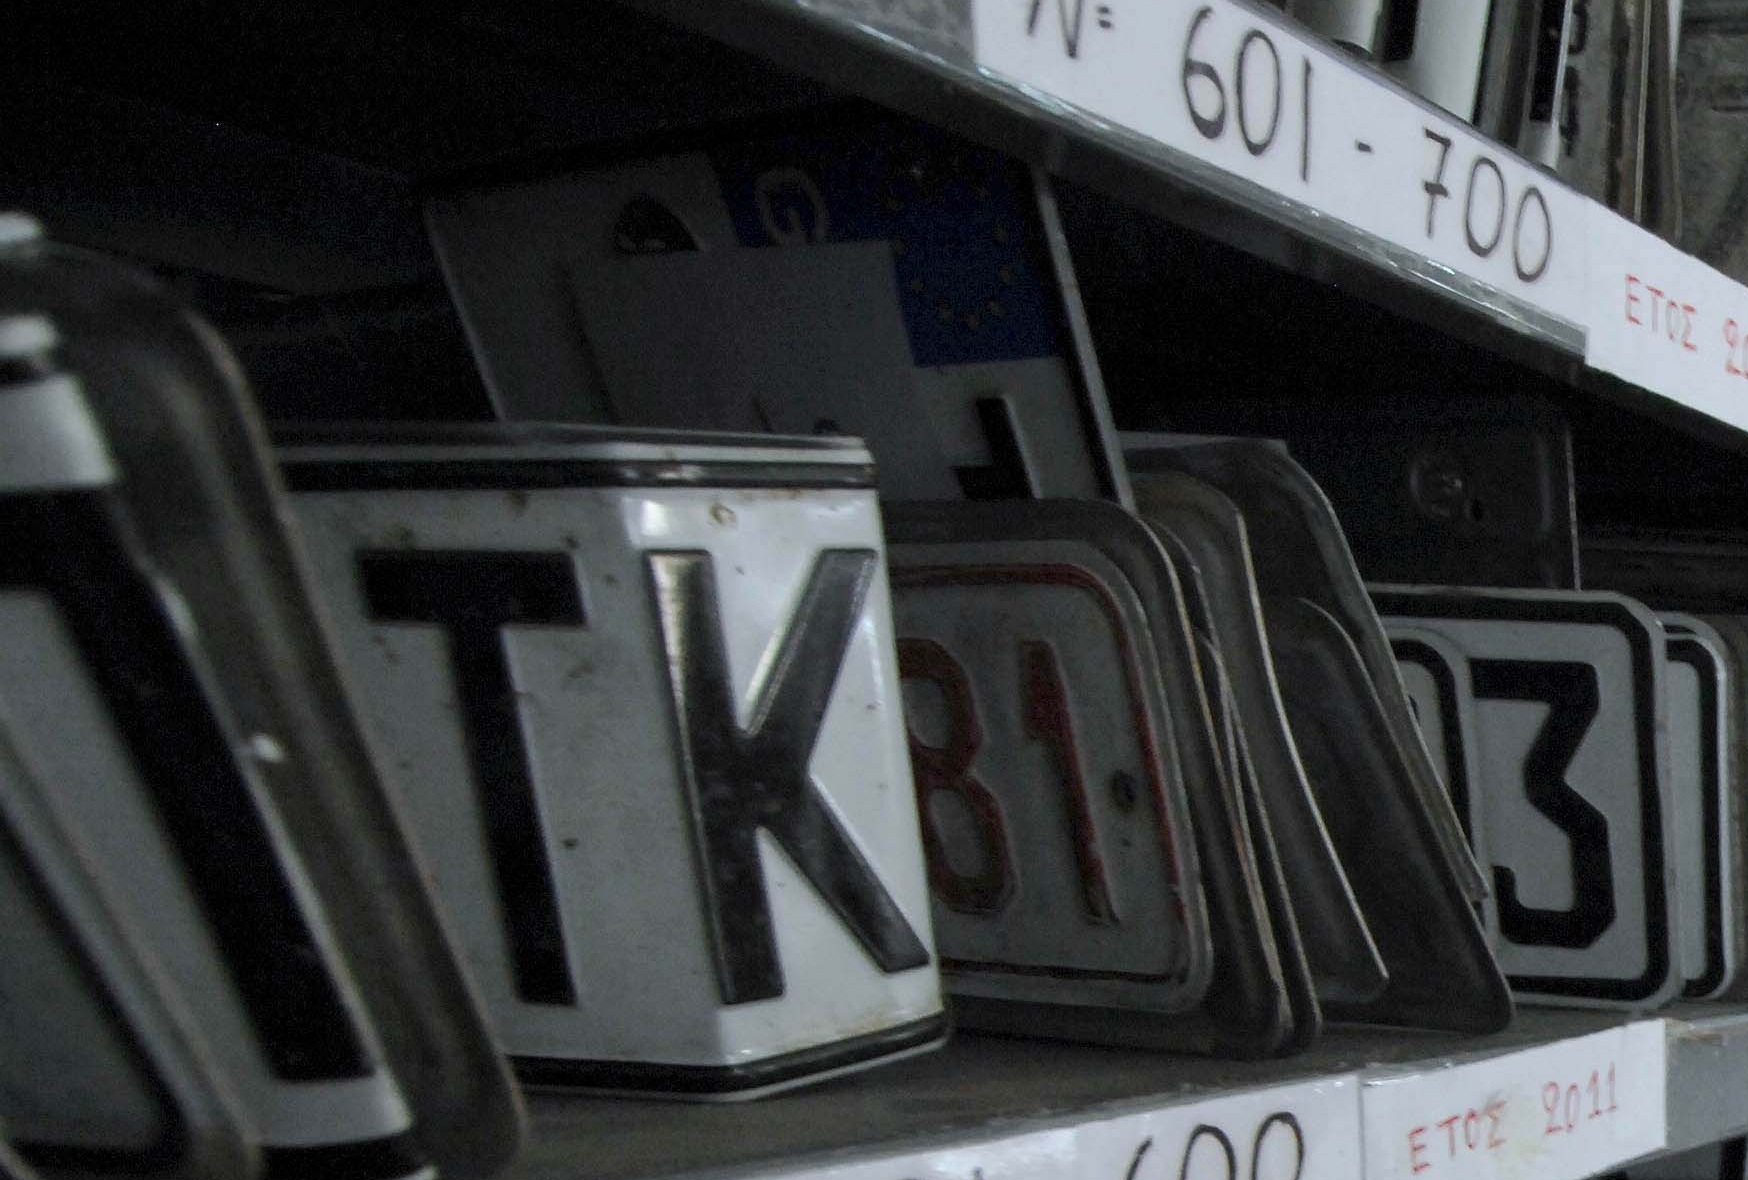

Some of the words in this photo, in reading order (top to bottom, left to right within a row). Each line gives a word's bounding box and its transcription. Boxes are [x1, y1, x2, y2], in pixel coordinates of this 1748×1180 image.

[1182, 6, 1311, 183] 601
[1423, 127, 1552, 283] 700
[1624, 273, 1698, 352] ΕΤΟΣ
[1469, 658, 1616, 950] 3
[1407, 1099, 1508, 1176] ΕΤΟΣ
[1541, 1061, 1619, 1136] 2011
